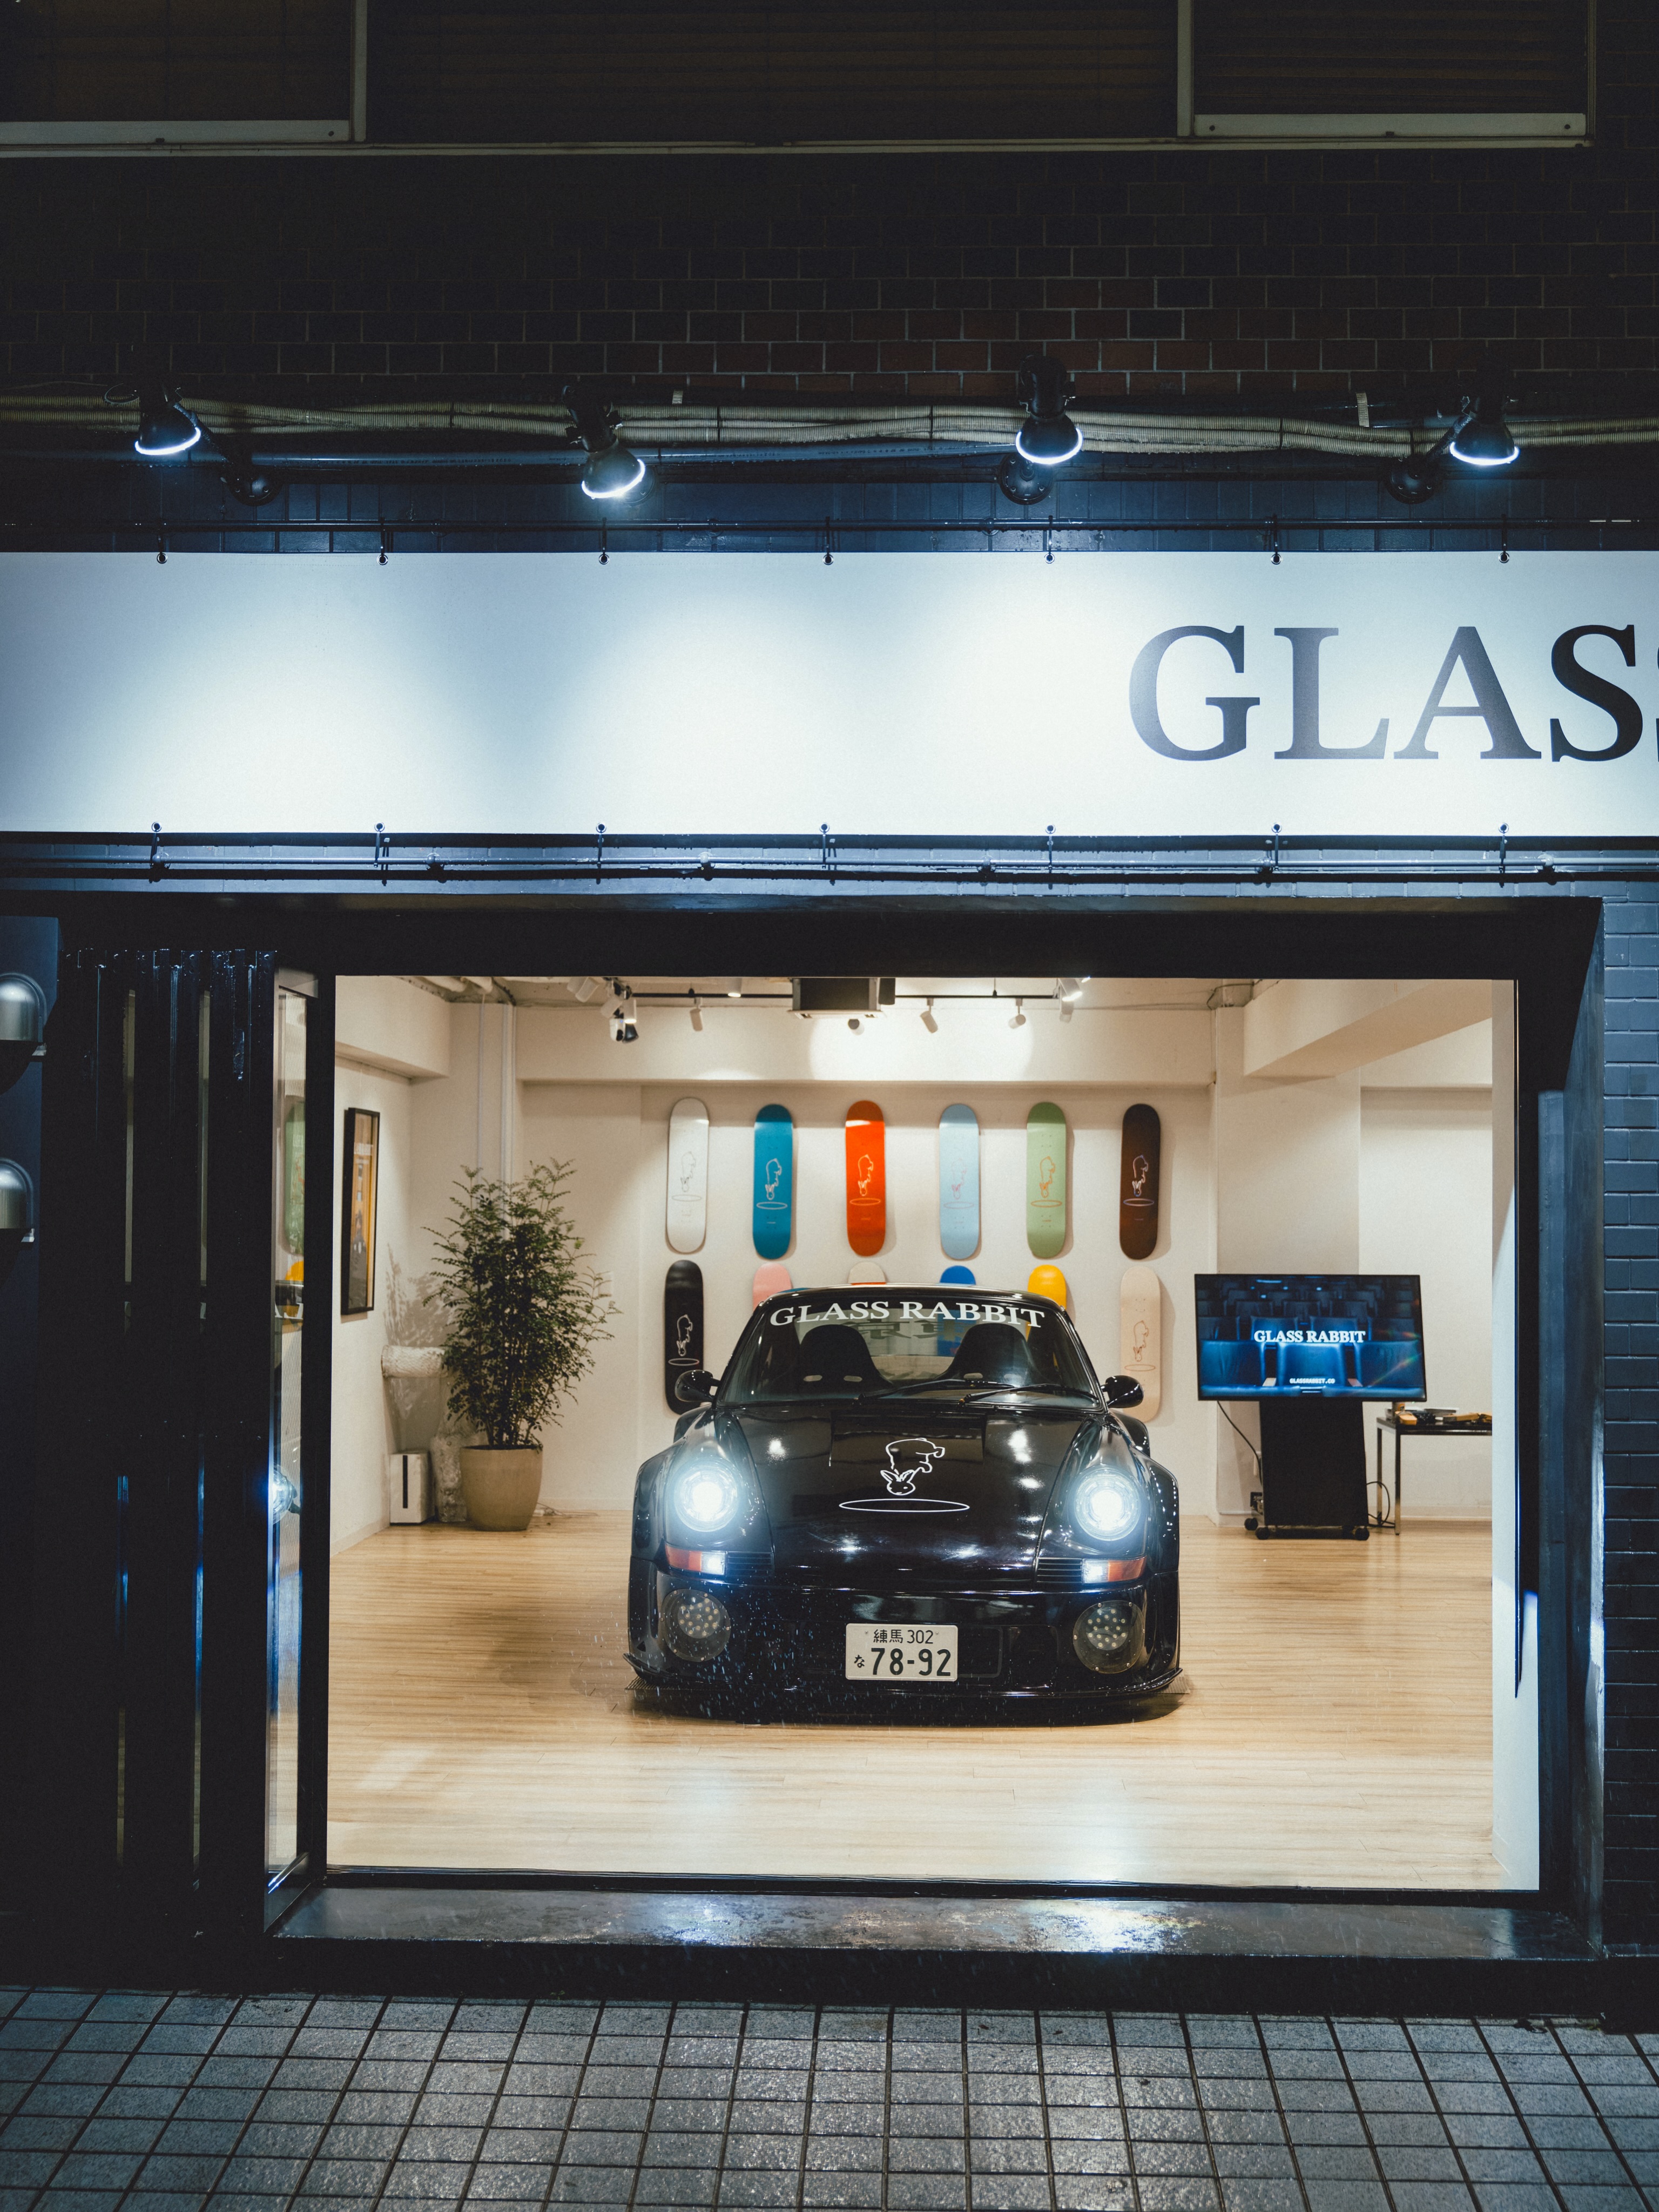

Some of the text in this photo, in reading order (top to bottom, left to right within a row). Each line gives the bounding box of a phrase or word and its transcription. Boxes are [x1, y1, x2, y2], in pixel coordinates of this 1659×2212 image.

[1129, 624, 1659, 763] GLAS
[770, 1301, 1045, 1328] GLASS RABBIT
[1253, 1330, 1366, 1343] GLASS RABBIT
[873, 1629, 934, 1644] 練馬 302
[854, 1647, 951, 1677] な 78-92
